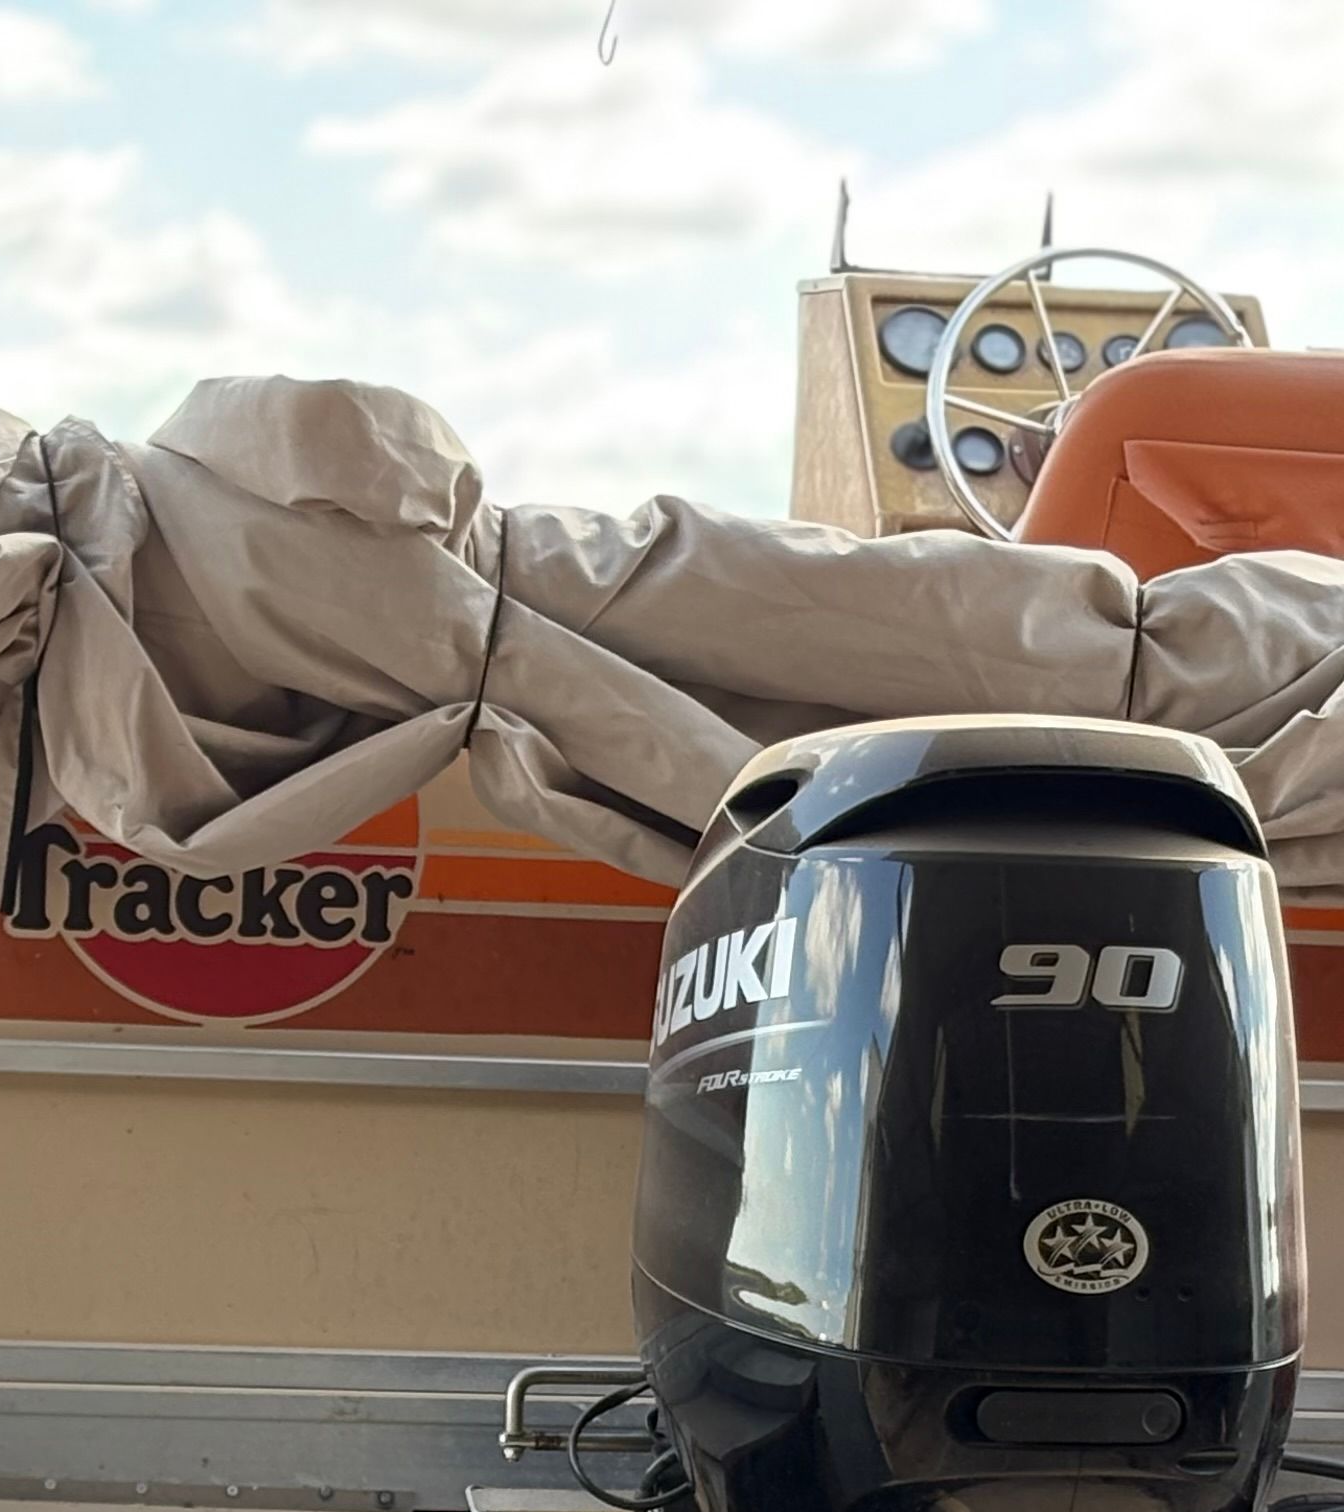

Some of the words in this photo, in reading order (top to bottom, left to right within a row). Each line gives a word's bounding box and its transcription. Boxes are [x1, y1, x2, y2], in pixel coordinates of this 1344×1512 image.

[11, 823, 413, 943] Tracker
[655, 917, 798, 1048] UZUKI
[990, 944, 1183, 1011] 90
